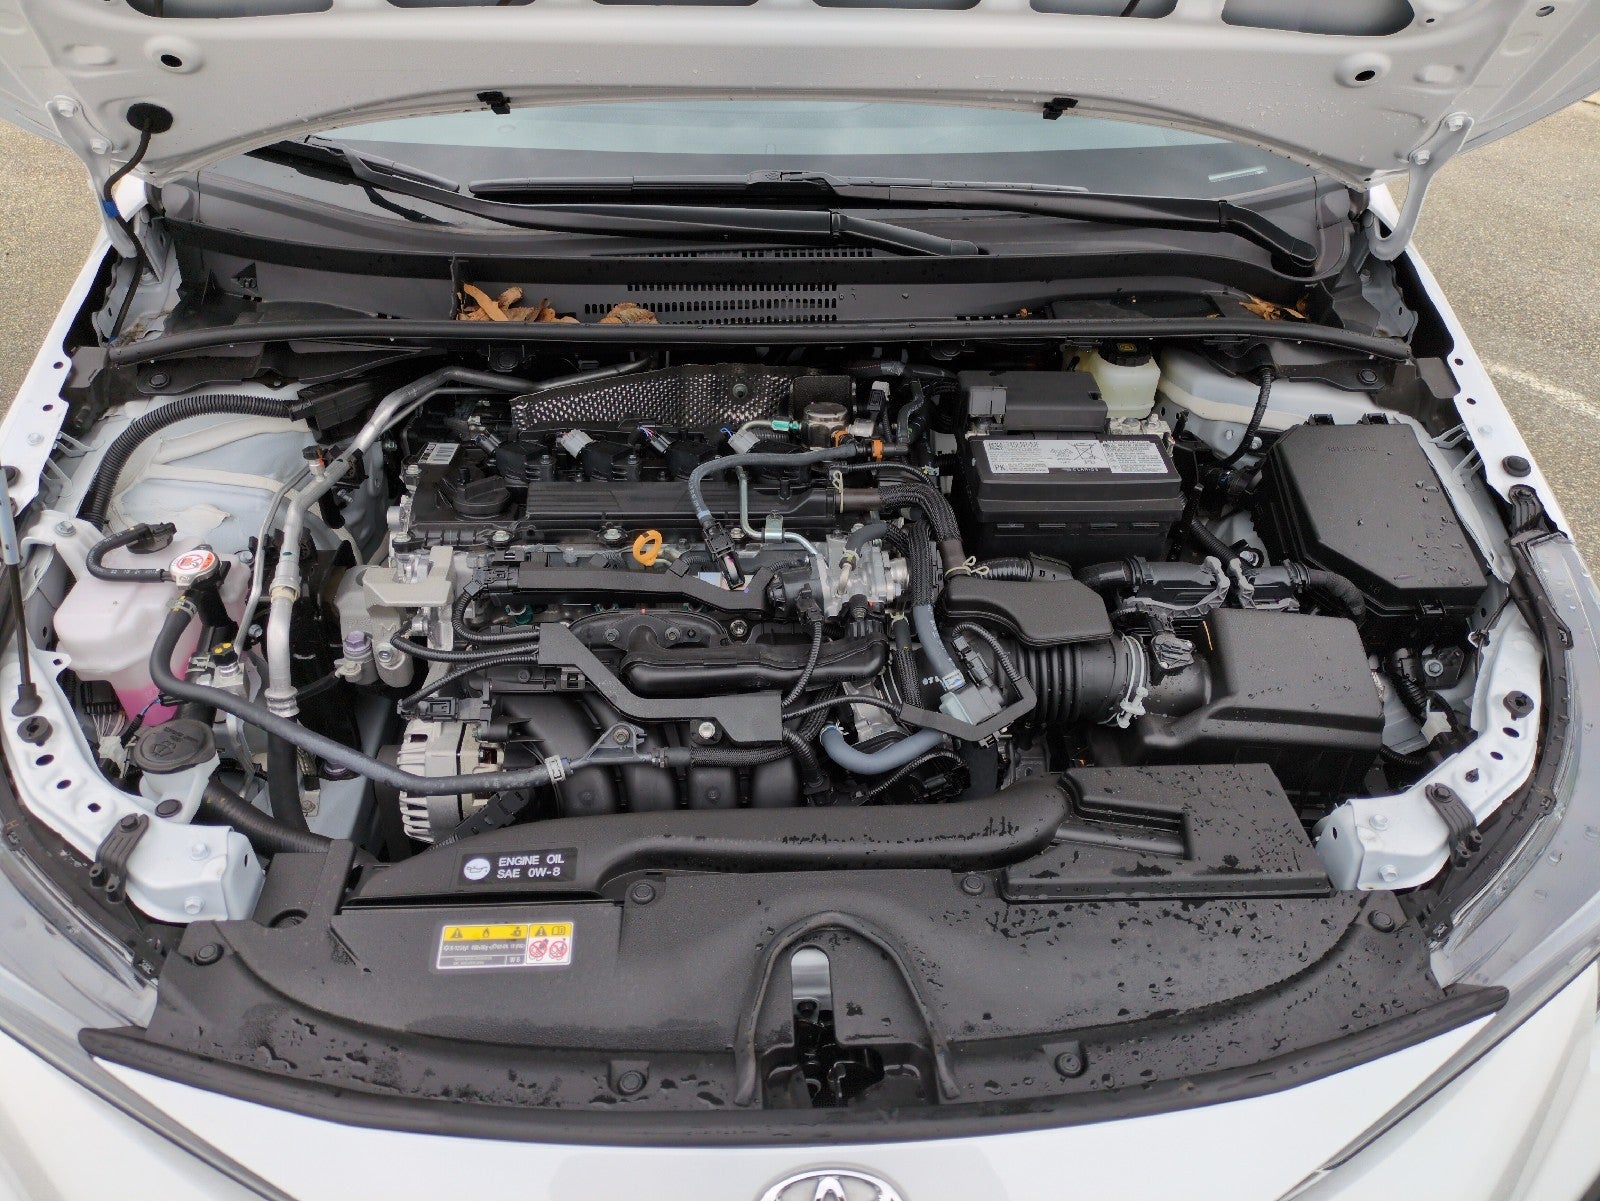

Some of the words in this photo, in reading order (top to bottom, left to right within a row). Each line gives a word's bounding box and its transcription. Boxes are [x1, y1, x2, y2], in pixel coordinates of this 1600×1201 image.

[498, 855, 540, 867] ENGINE
[546, 854, 565, 864] OIL
[496, 868, 521, 879] SAE
[527, 867, 561, 878] 0W-8
